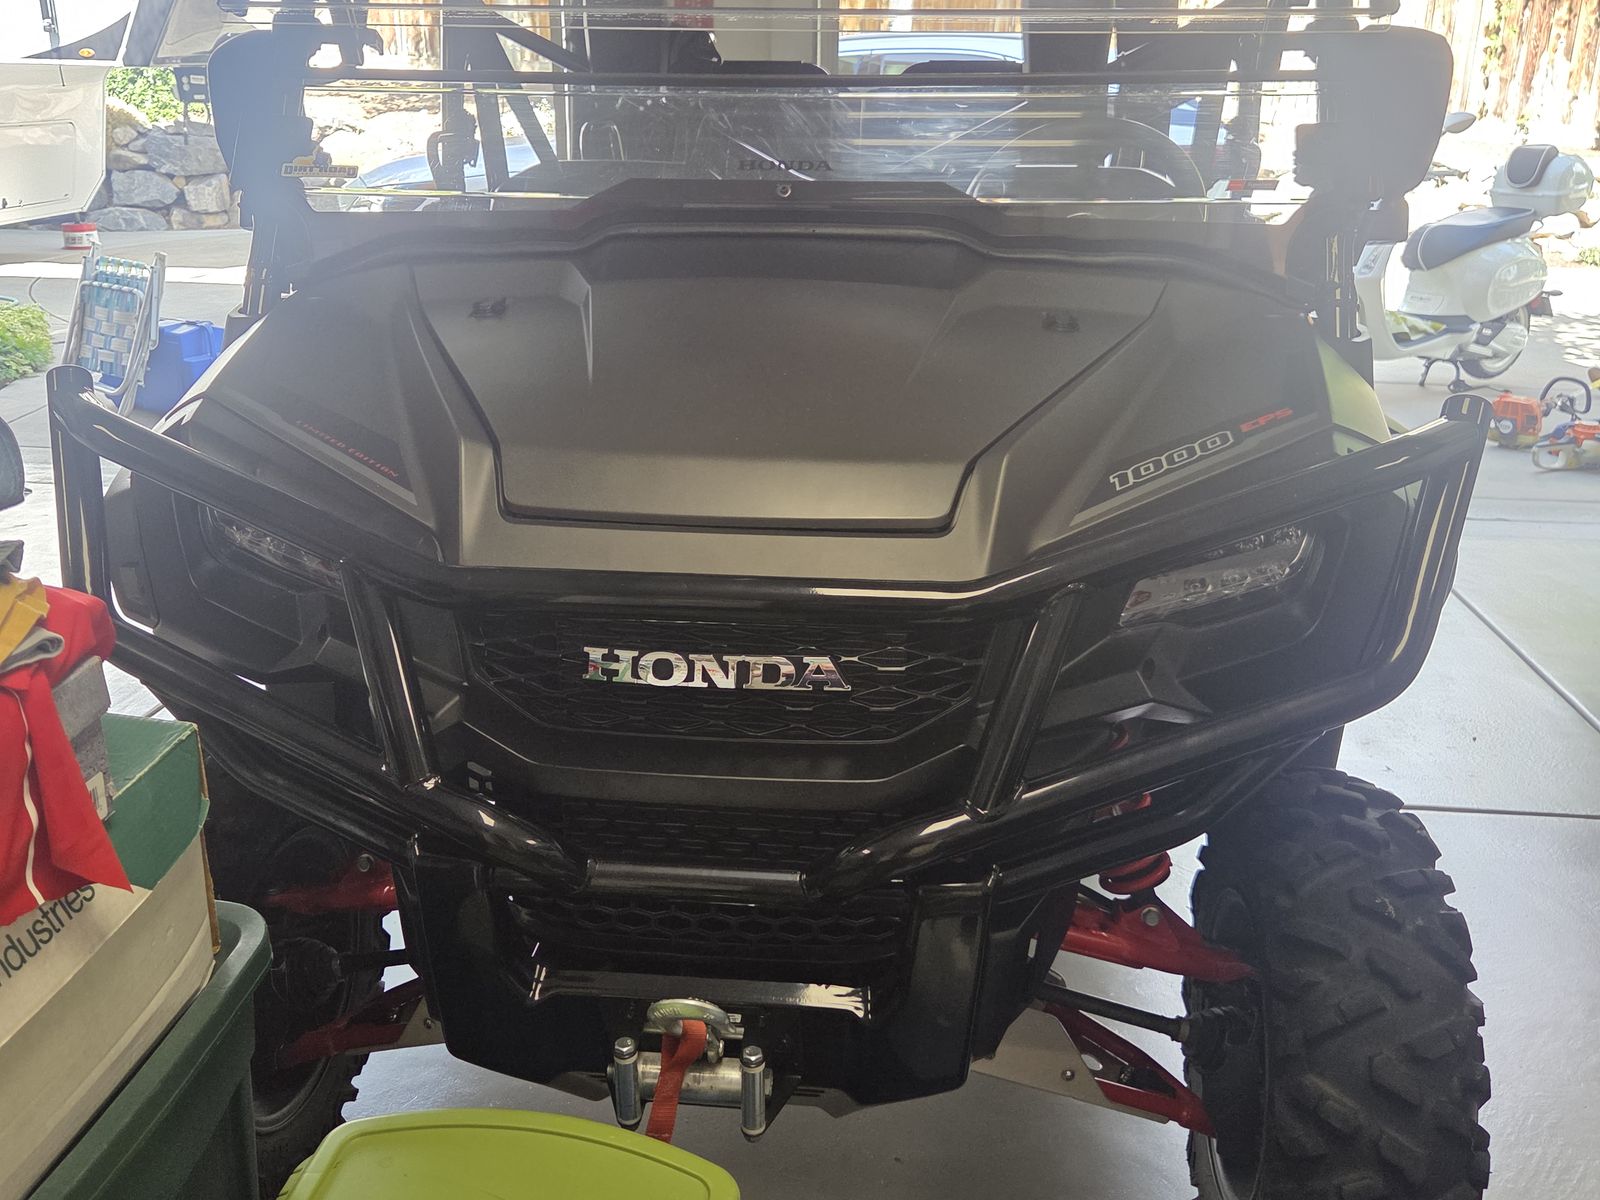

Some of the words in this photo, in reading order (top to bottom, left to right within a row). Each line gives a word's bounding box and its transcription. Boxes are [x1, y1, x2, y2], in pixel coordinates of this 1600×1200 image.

[738, 160, 833, 171] HONDA
[1110, 430, 1234, 491] 1000
[1239, 407, 1293, 432] EPS
[582, 646, 851, 691] HONDA
